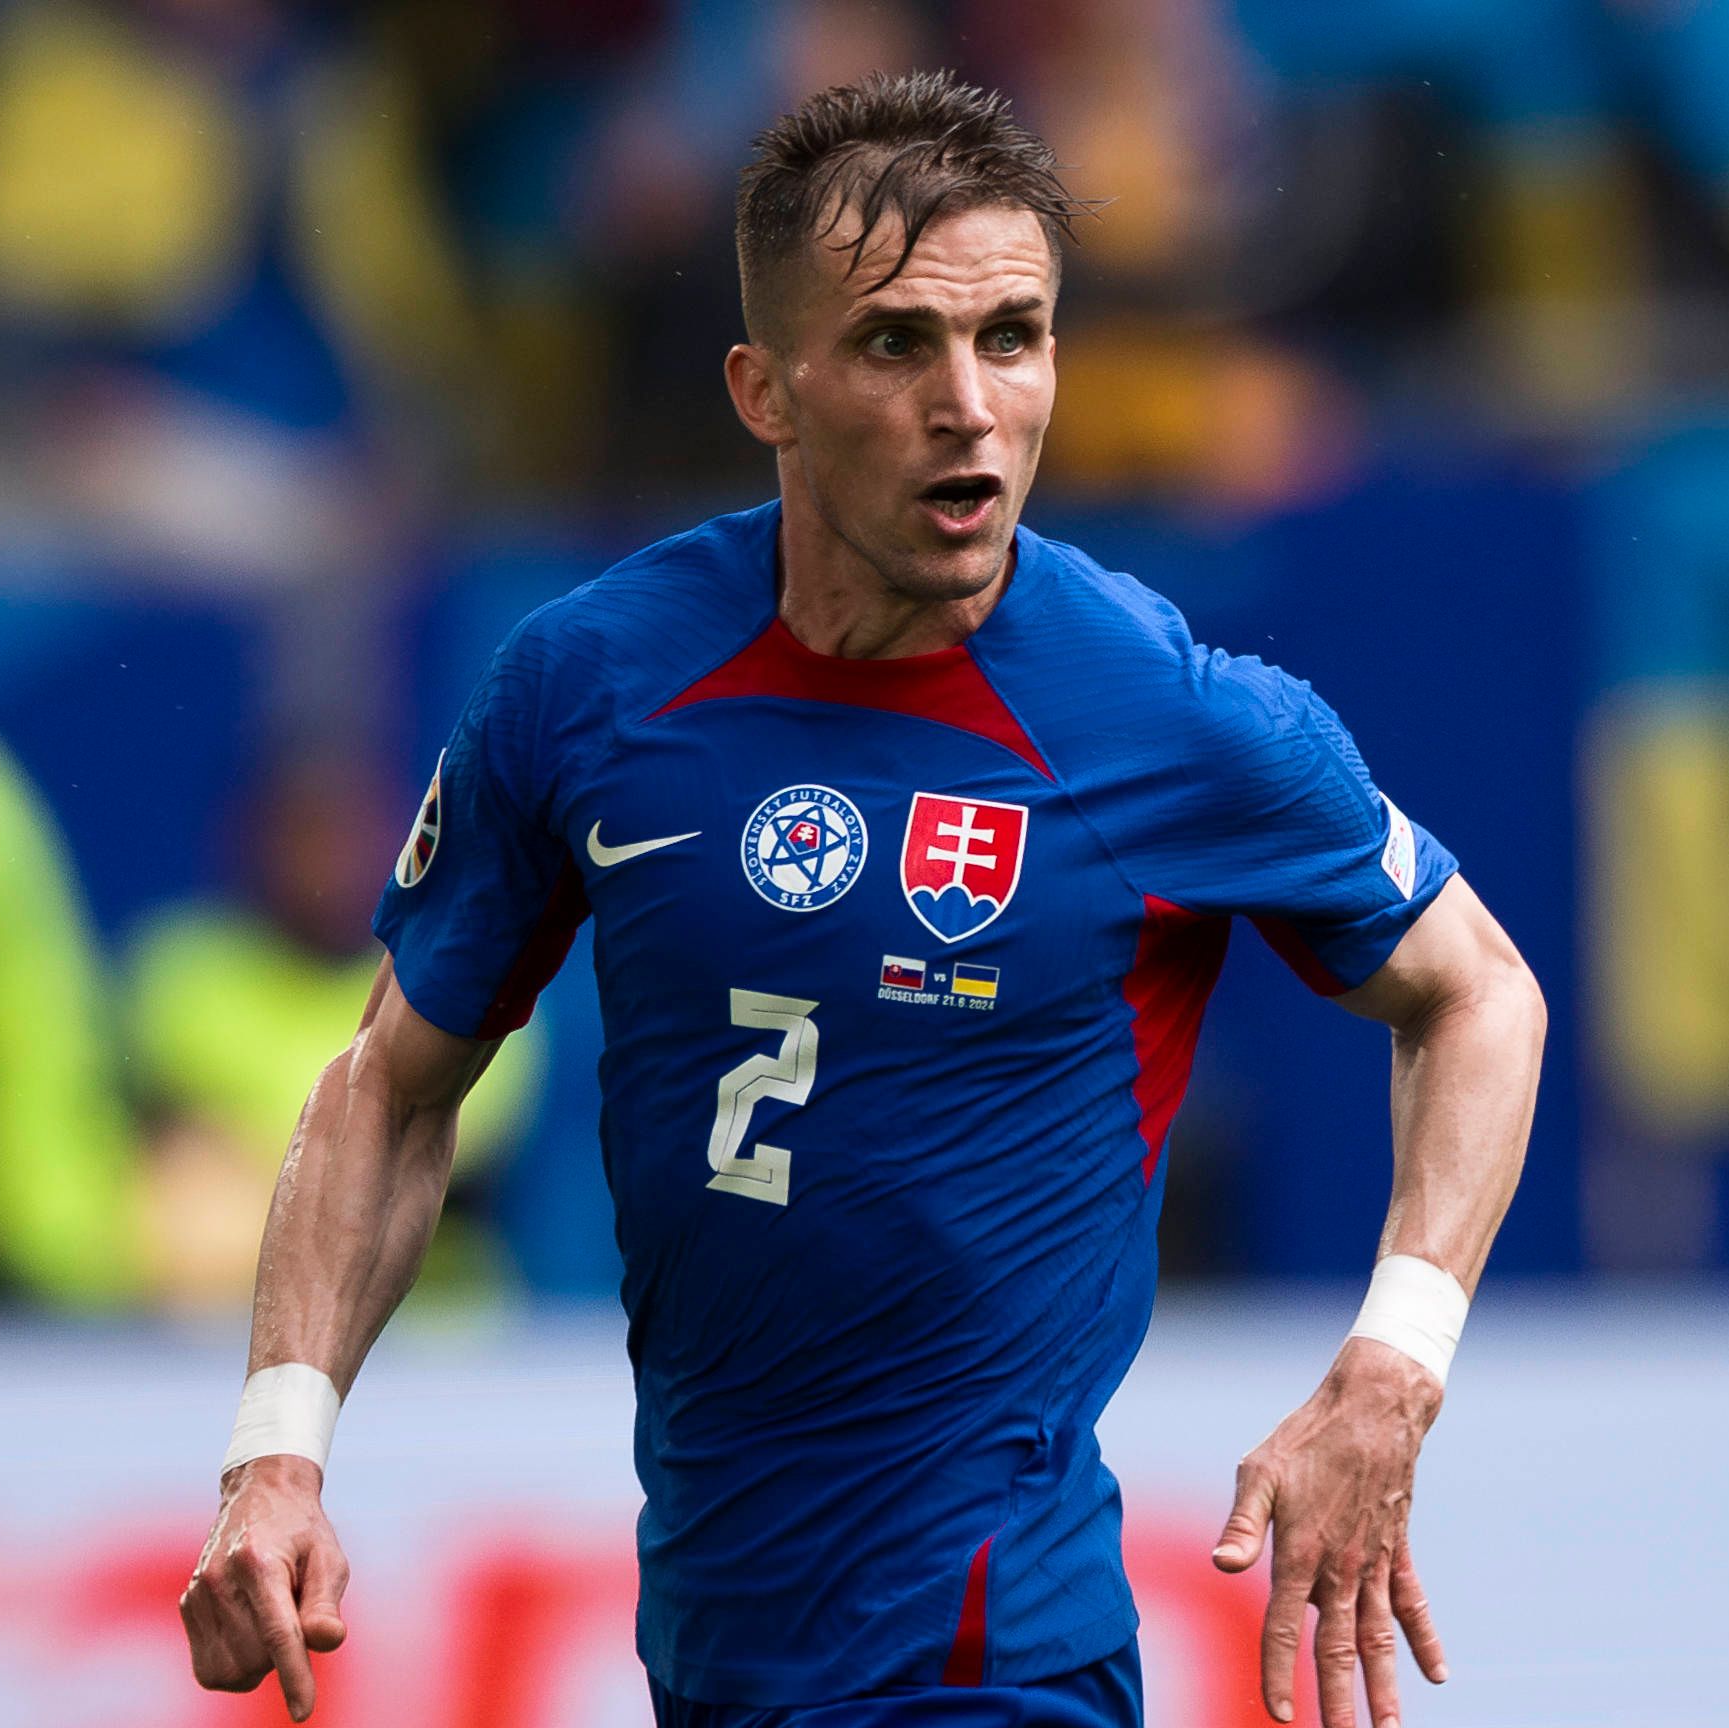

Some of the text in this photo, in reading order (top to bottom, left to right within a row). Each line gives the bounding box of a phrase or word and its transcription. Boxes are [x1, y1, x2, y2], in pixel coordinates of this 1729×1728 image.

[779, 892, 814, 907] SFZ
[877, 987, 940, 1005] DÜSSELDORF
[705, 988, 820, 1207] 2
